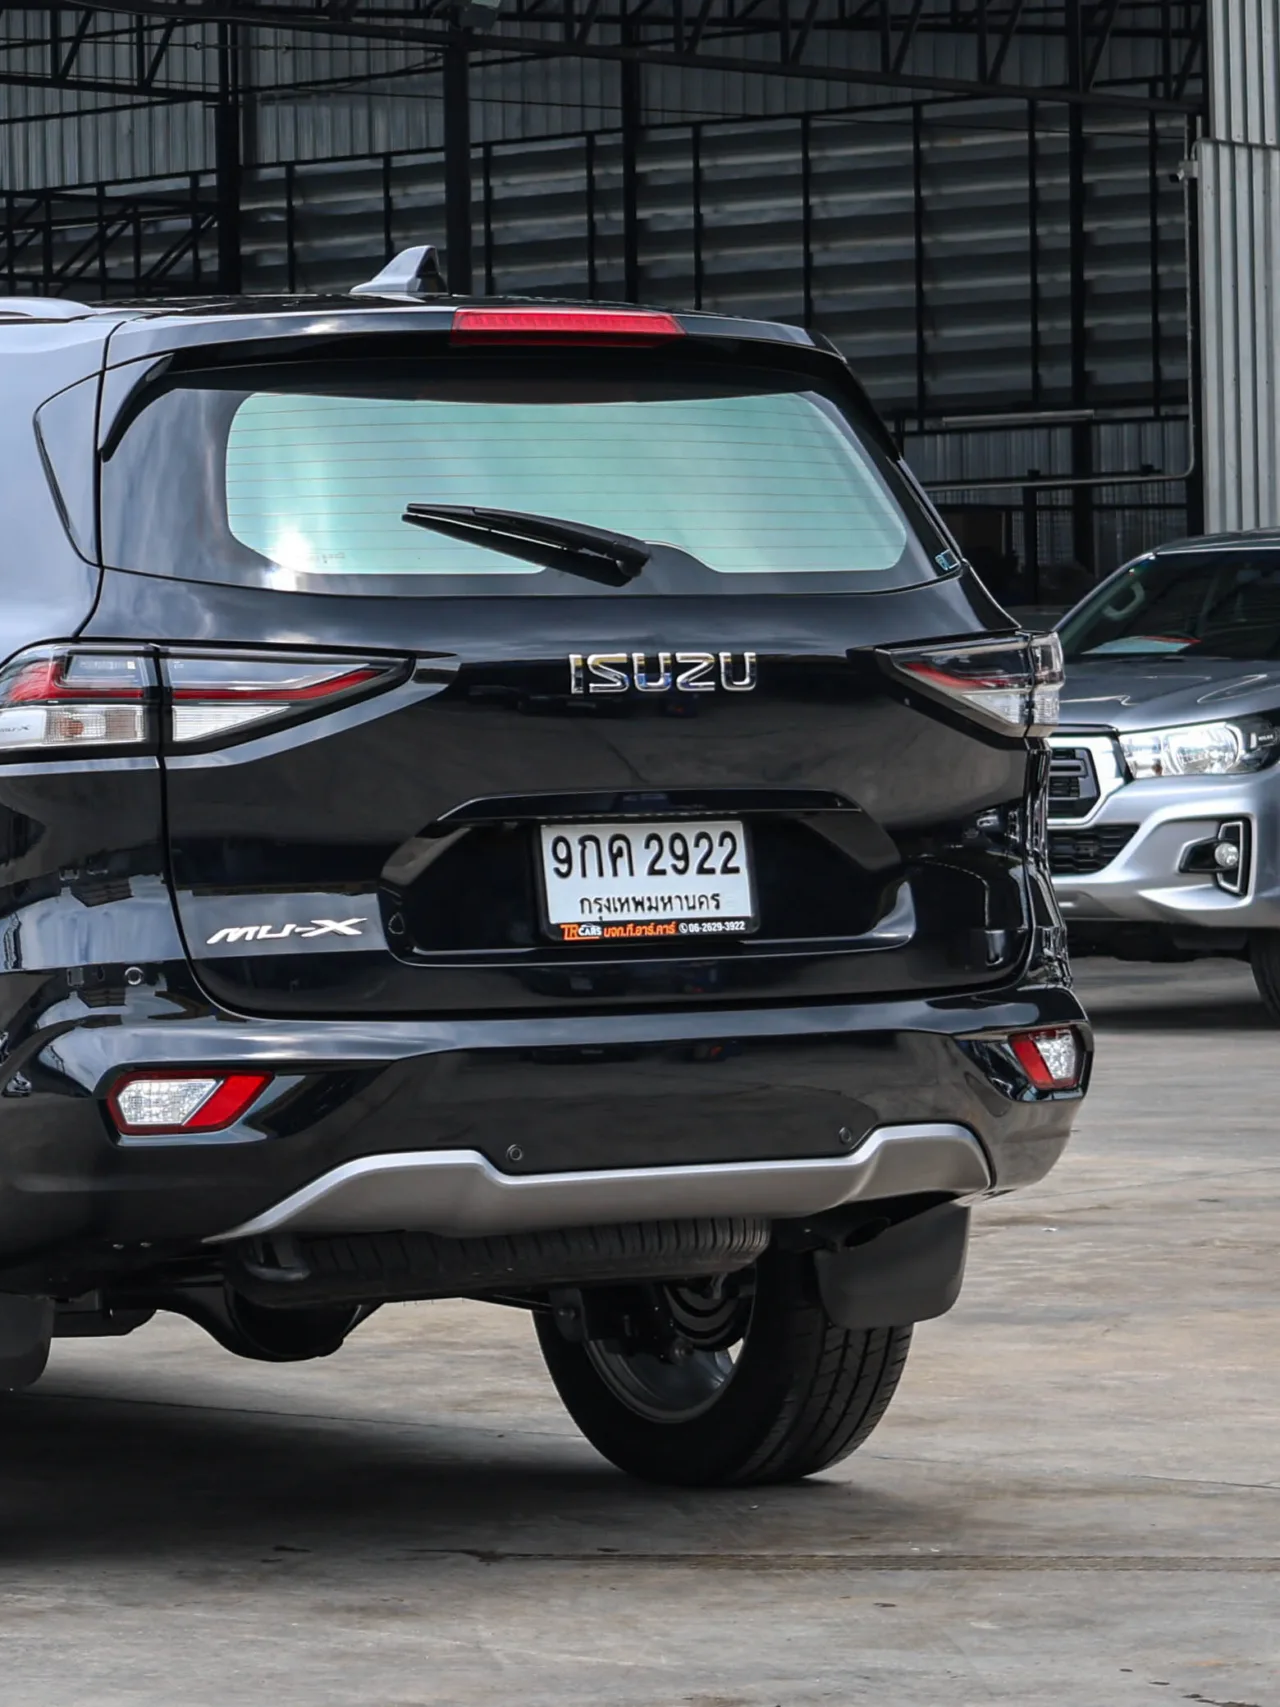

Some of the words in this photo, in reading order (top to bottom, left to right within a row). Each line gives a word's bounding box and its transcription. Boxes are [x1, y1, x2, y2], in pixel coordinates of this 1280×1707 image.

[569, 652, 757, 694] ISUZU
[551, 833, 635, 879] 9กค
[643, 830, 741, 876] 2922
[579, 892, 721, 921] กรุงเทพมหานคร
[206, 917, 369, 945] MU-X
